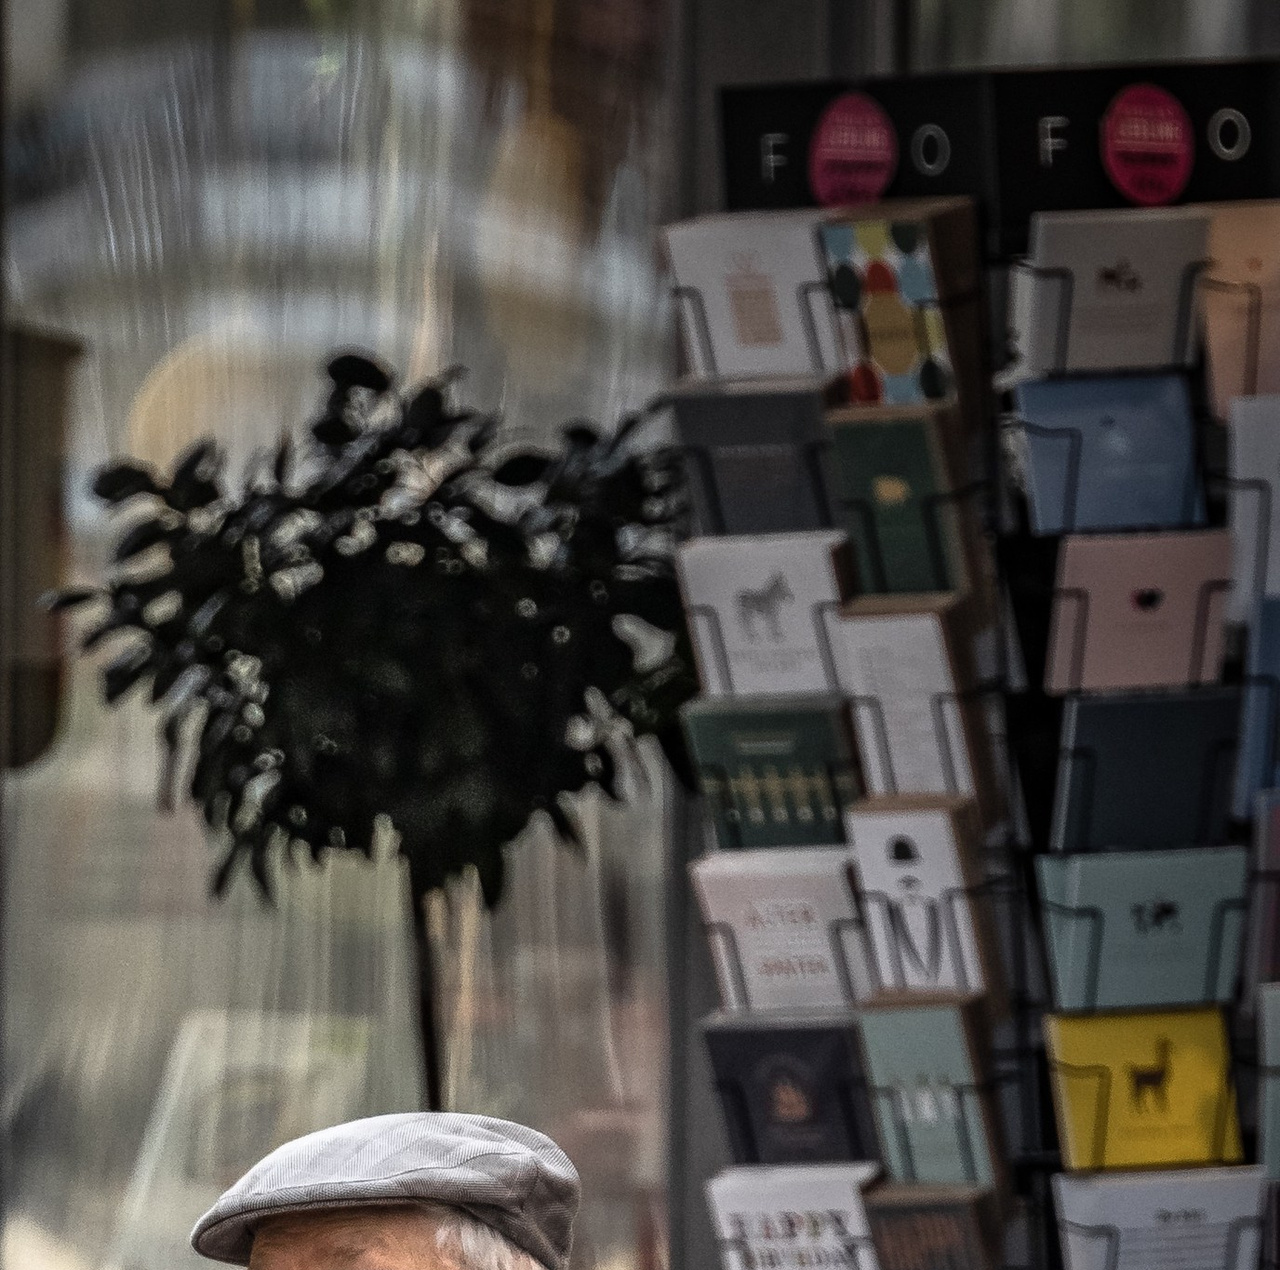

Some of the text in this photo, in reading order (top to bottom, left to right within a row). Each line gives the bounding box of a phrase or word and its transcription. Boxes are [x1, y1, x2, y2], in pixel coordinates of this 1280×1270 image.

[760, 132, 790, 184] F
[911, 124, 951, 177] O
[1037, 115, 1070, 169] F
[1207, 108, 1252, 161] O
